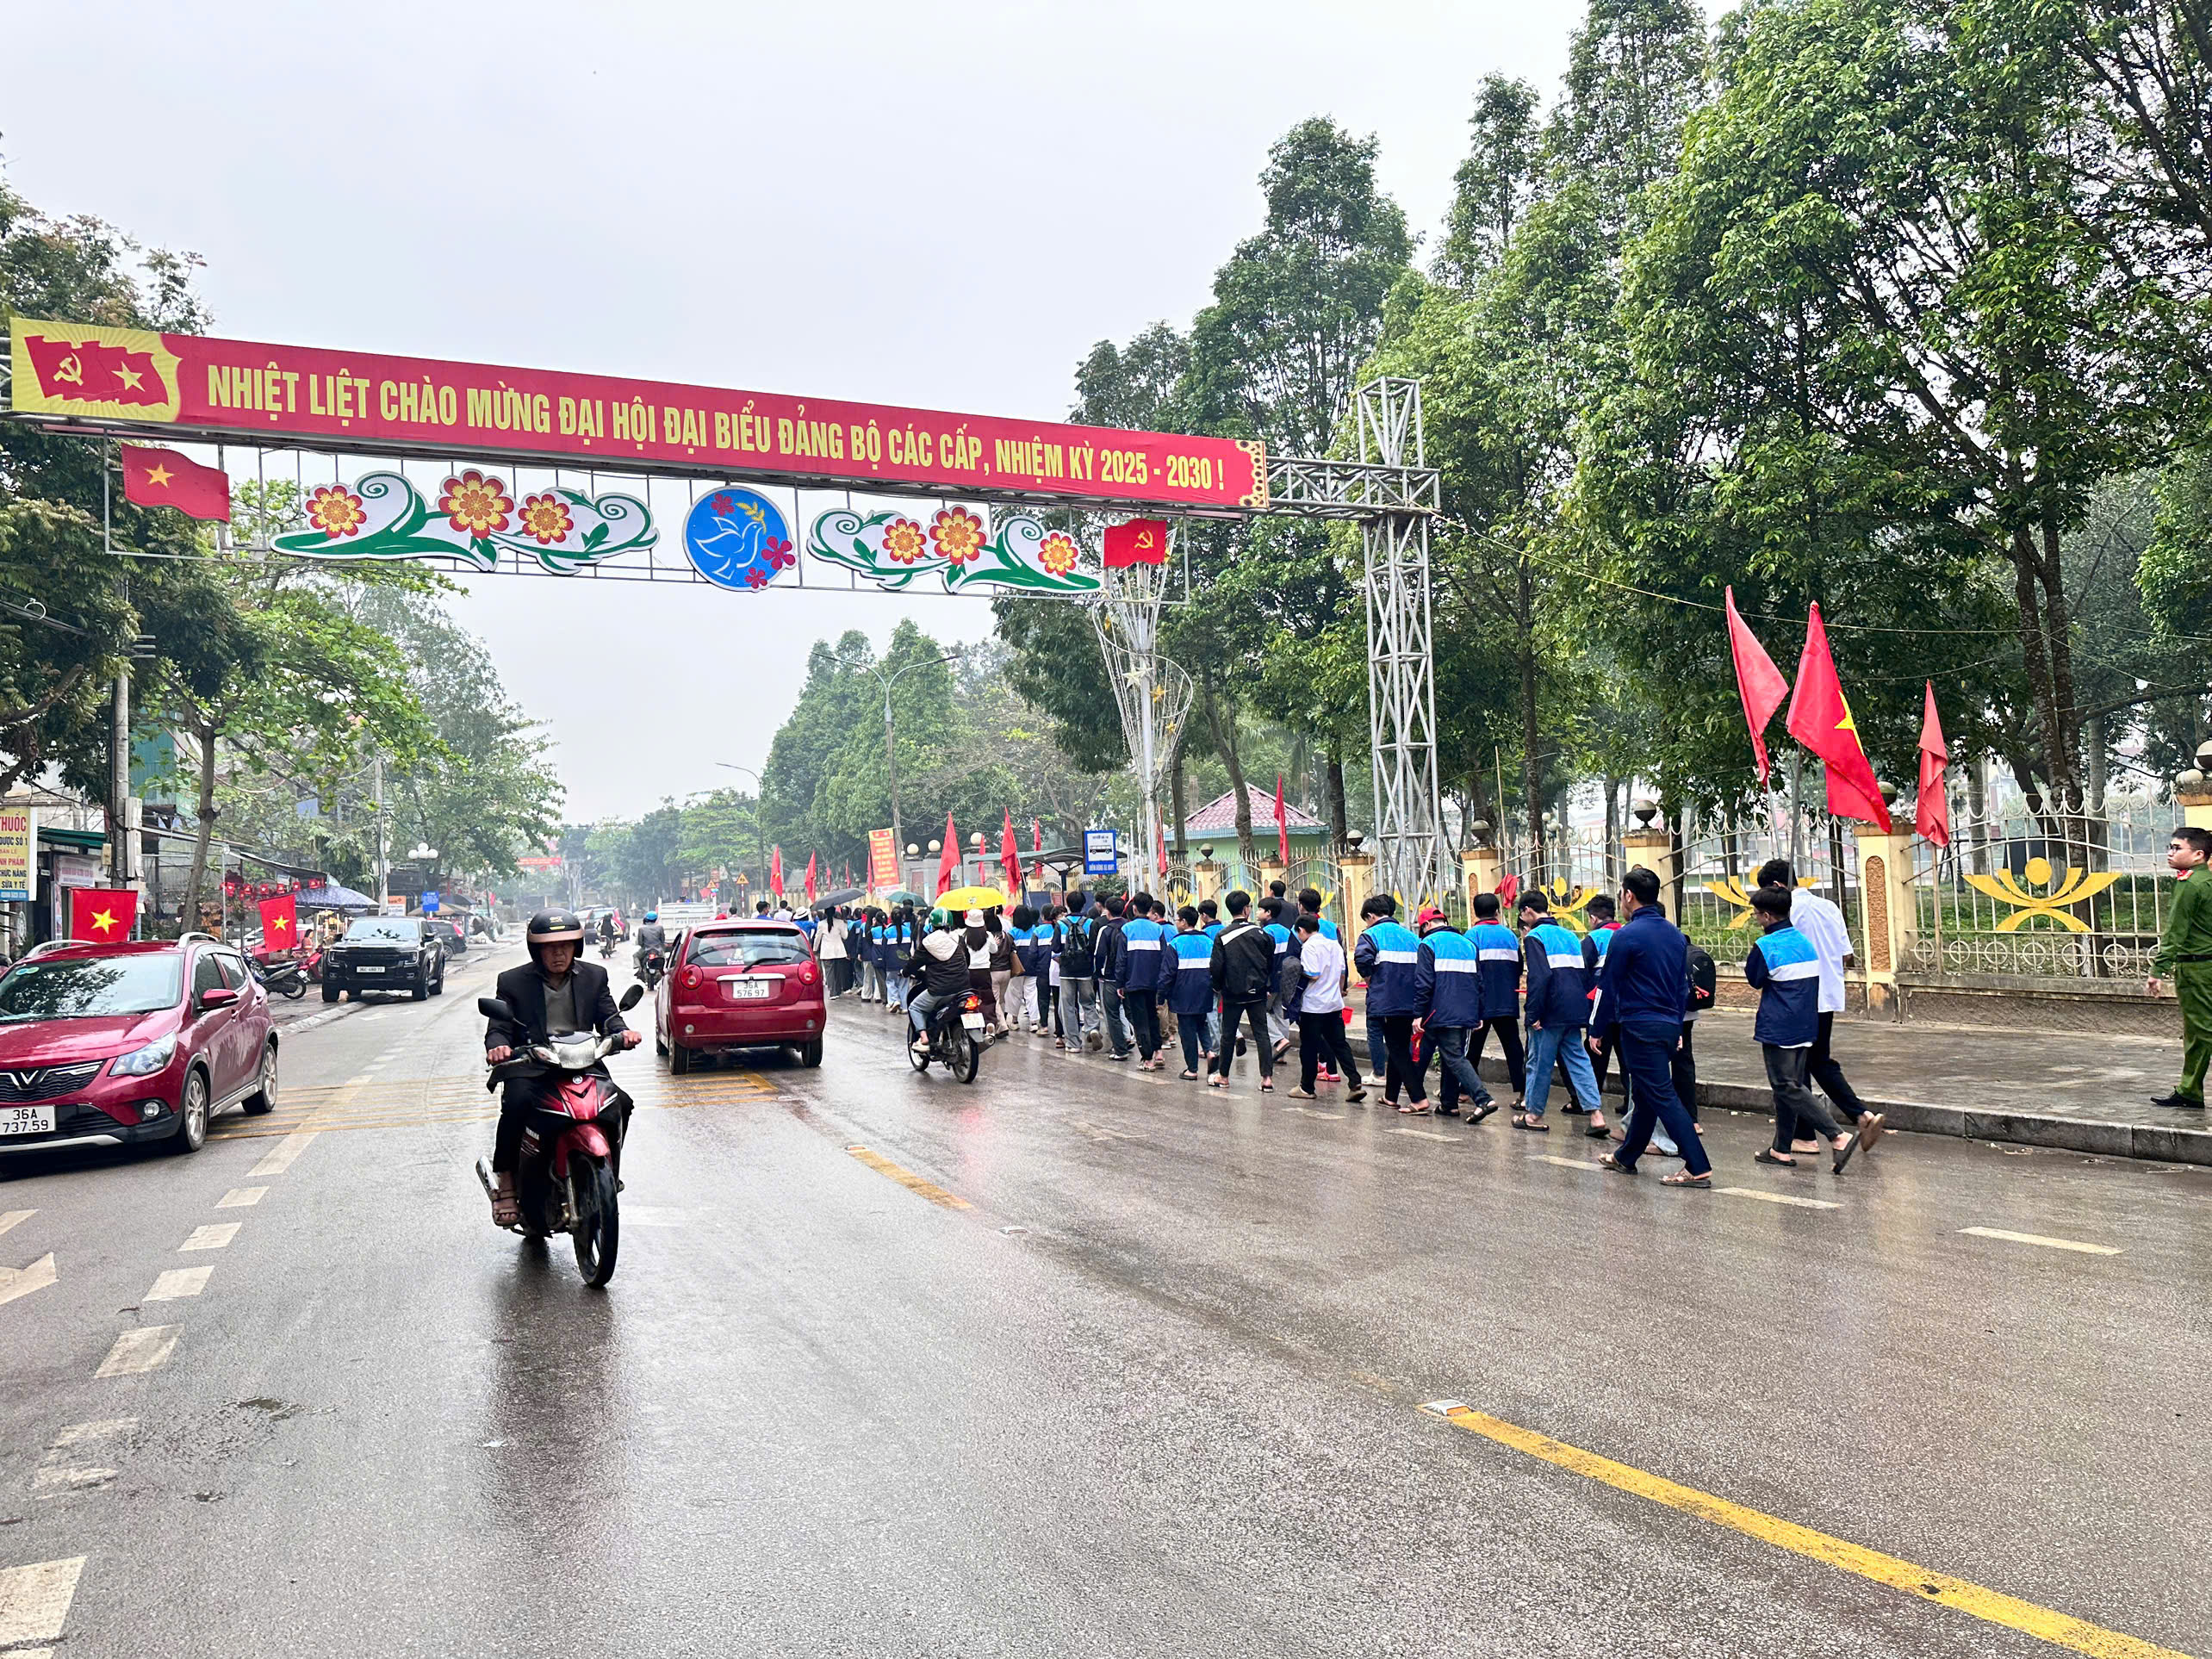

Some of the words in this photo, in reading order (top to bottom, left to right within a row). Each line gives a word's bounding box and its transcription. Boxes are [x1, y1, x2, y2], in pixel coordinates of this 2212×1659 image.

[208, 361, 299, 421] NHIỆT
[309, 368, 370, 426] LIỆT
[380, 376, 457, 426] CHÀO
[467, 381, 550, 433] MỪNG
[558, 396, 604, 445] ĐẠI
[612, 395, 656, 450] HỘI
[663, 407, 706, 454] ĐẠI
[714, 400, 771, 453] BIỂU
[778, 404, 844, 459] ĐẢNG
[850, 419, 880, 470] BỘ
[888, 423, 933, 467] CÁC
[939, 423, 990, 476] CẤP,
[995, 435, 1063, 484] NHIỆM
[1069, 440, 1094, 480] KỲ
[1100, 449, 1147, 485] 2025
[1165, 454, 1212, 489] 2030
[1217, 458, 1224, 490] !
[0, 811, 27, 832] HUỐC
[13, 1109, 38, 1120] 36A
[3, 1120, 48, 1133] 737.59
